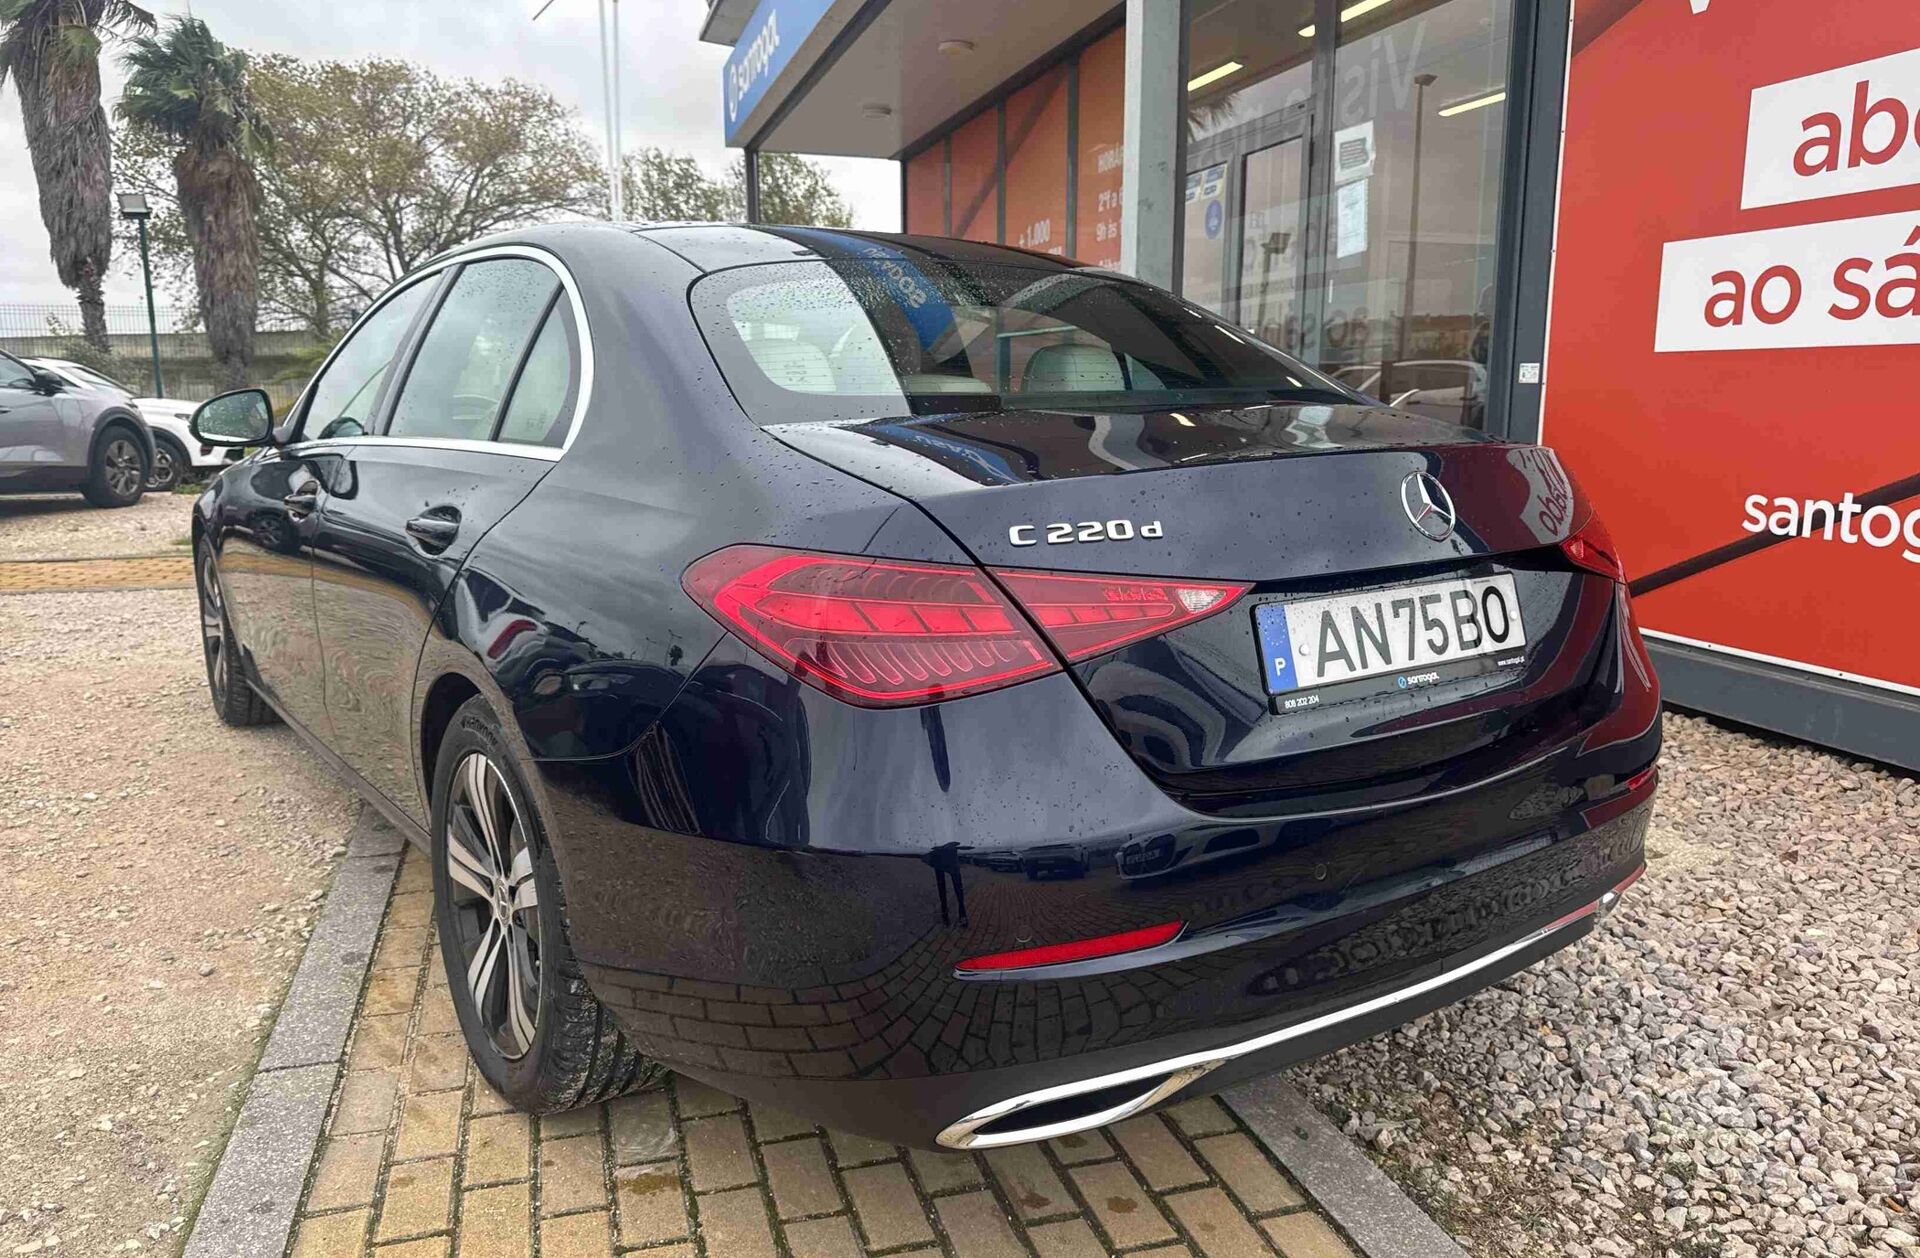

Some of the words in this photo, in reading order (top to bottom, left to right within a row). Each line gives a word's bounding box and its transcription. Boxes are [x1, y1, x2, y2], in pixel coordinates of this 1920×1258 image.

[1793, 79, 1920, 177] ab
[1704, 269, 1802, 328] ao
[1827, 225, 1920, 321] sá
[1008, 524, 1037, 546] C
[1046, 519, 1134, 545] 220
[1274, 657, 1287, 677] P
[1407, 671, 1440, 685] santogal
